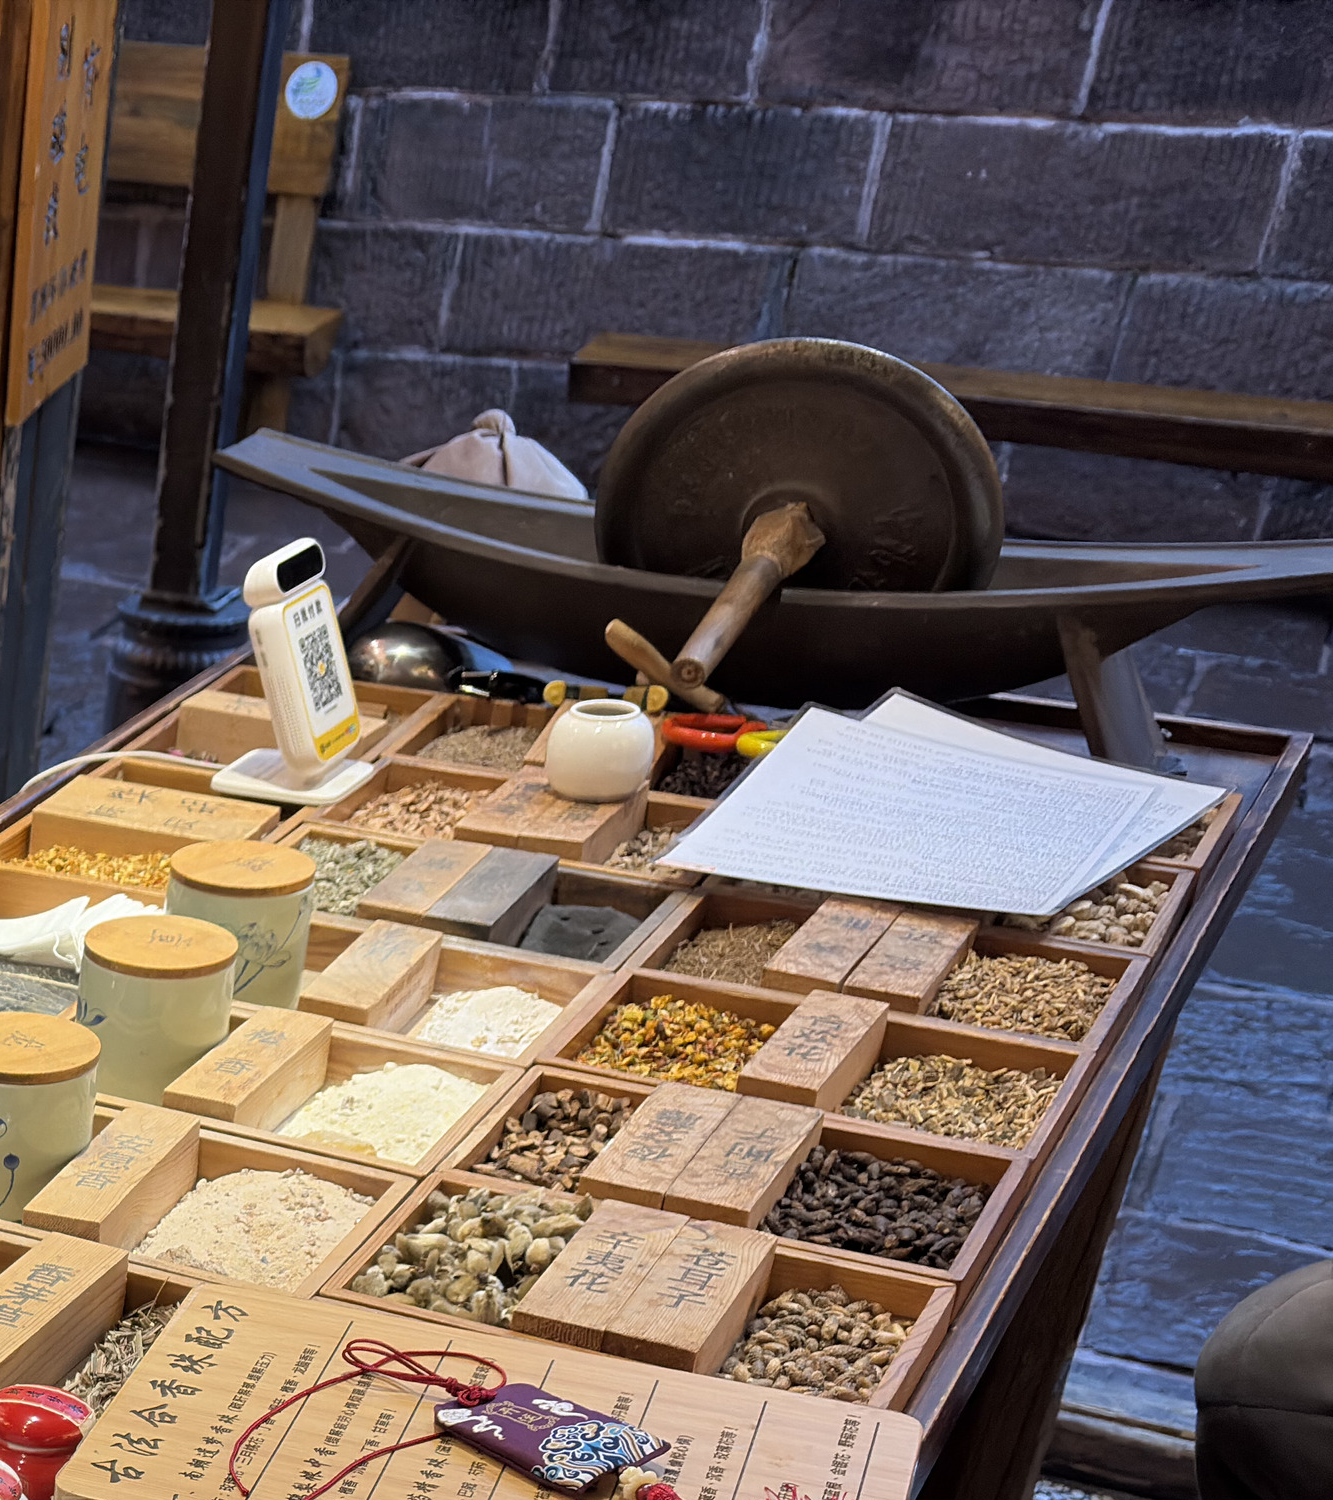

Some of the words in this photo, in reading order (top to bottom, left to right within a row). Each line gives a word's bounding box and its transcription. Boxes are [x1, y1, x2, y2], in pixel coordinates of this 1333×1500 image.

[75, 1134, 154, 1190] 安息香
[564, 1230, 645, 1294] 辛夷花
[656, 1247, 738, 1309] 苍耳子
[82, 1294, 254, 1492] 古法合香珠配方
